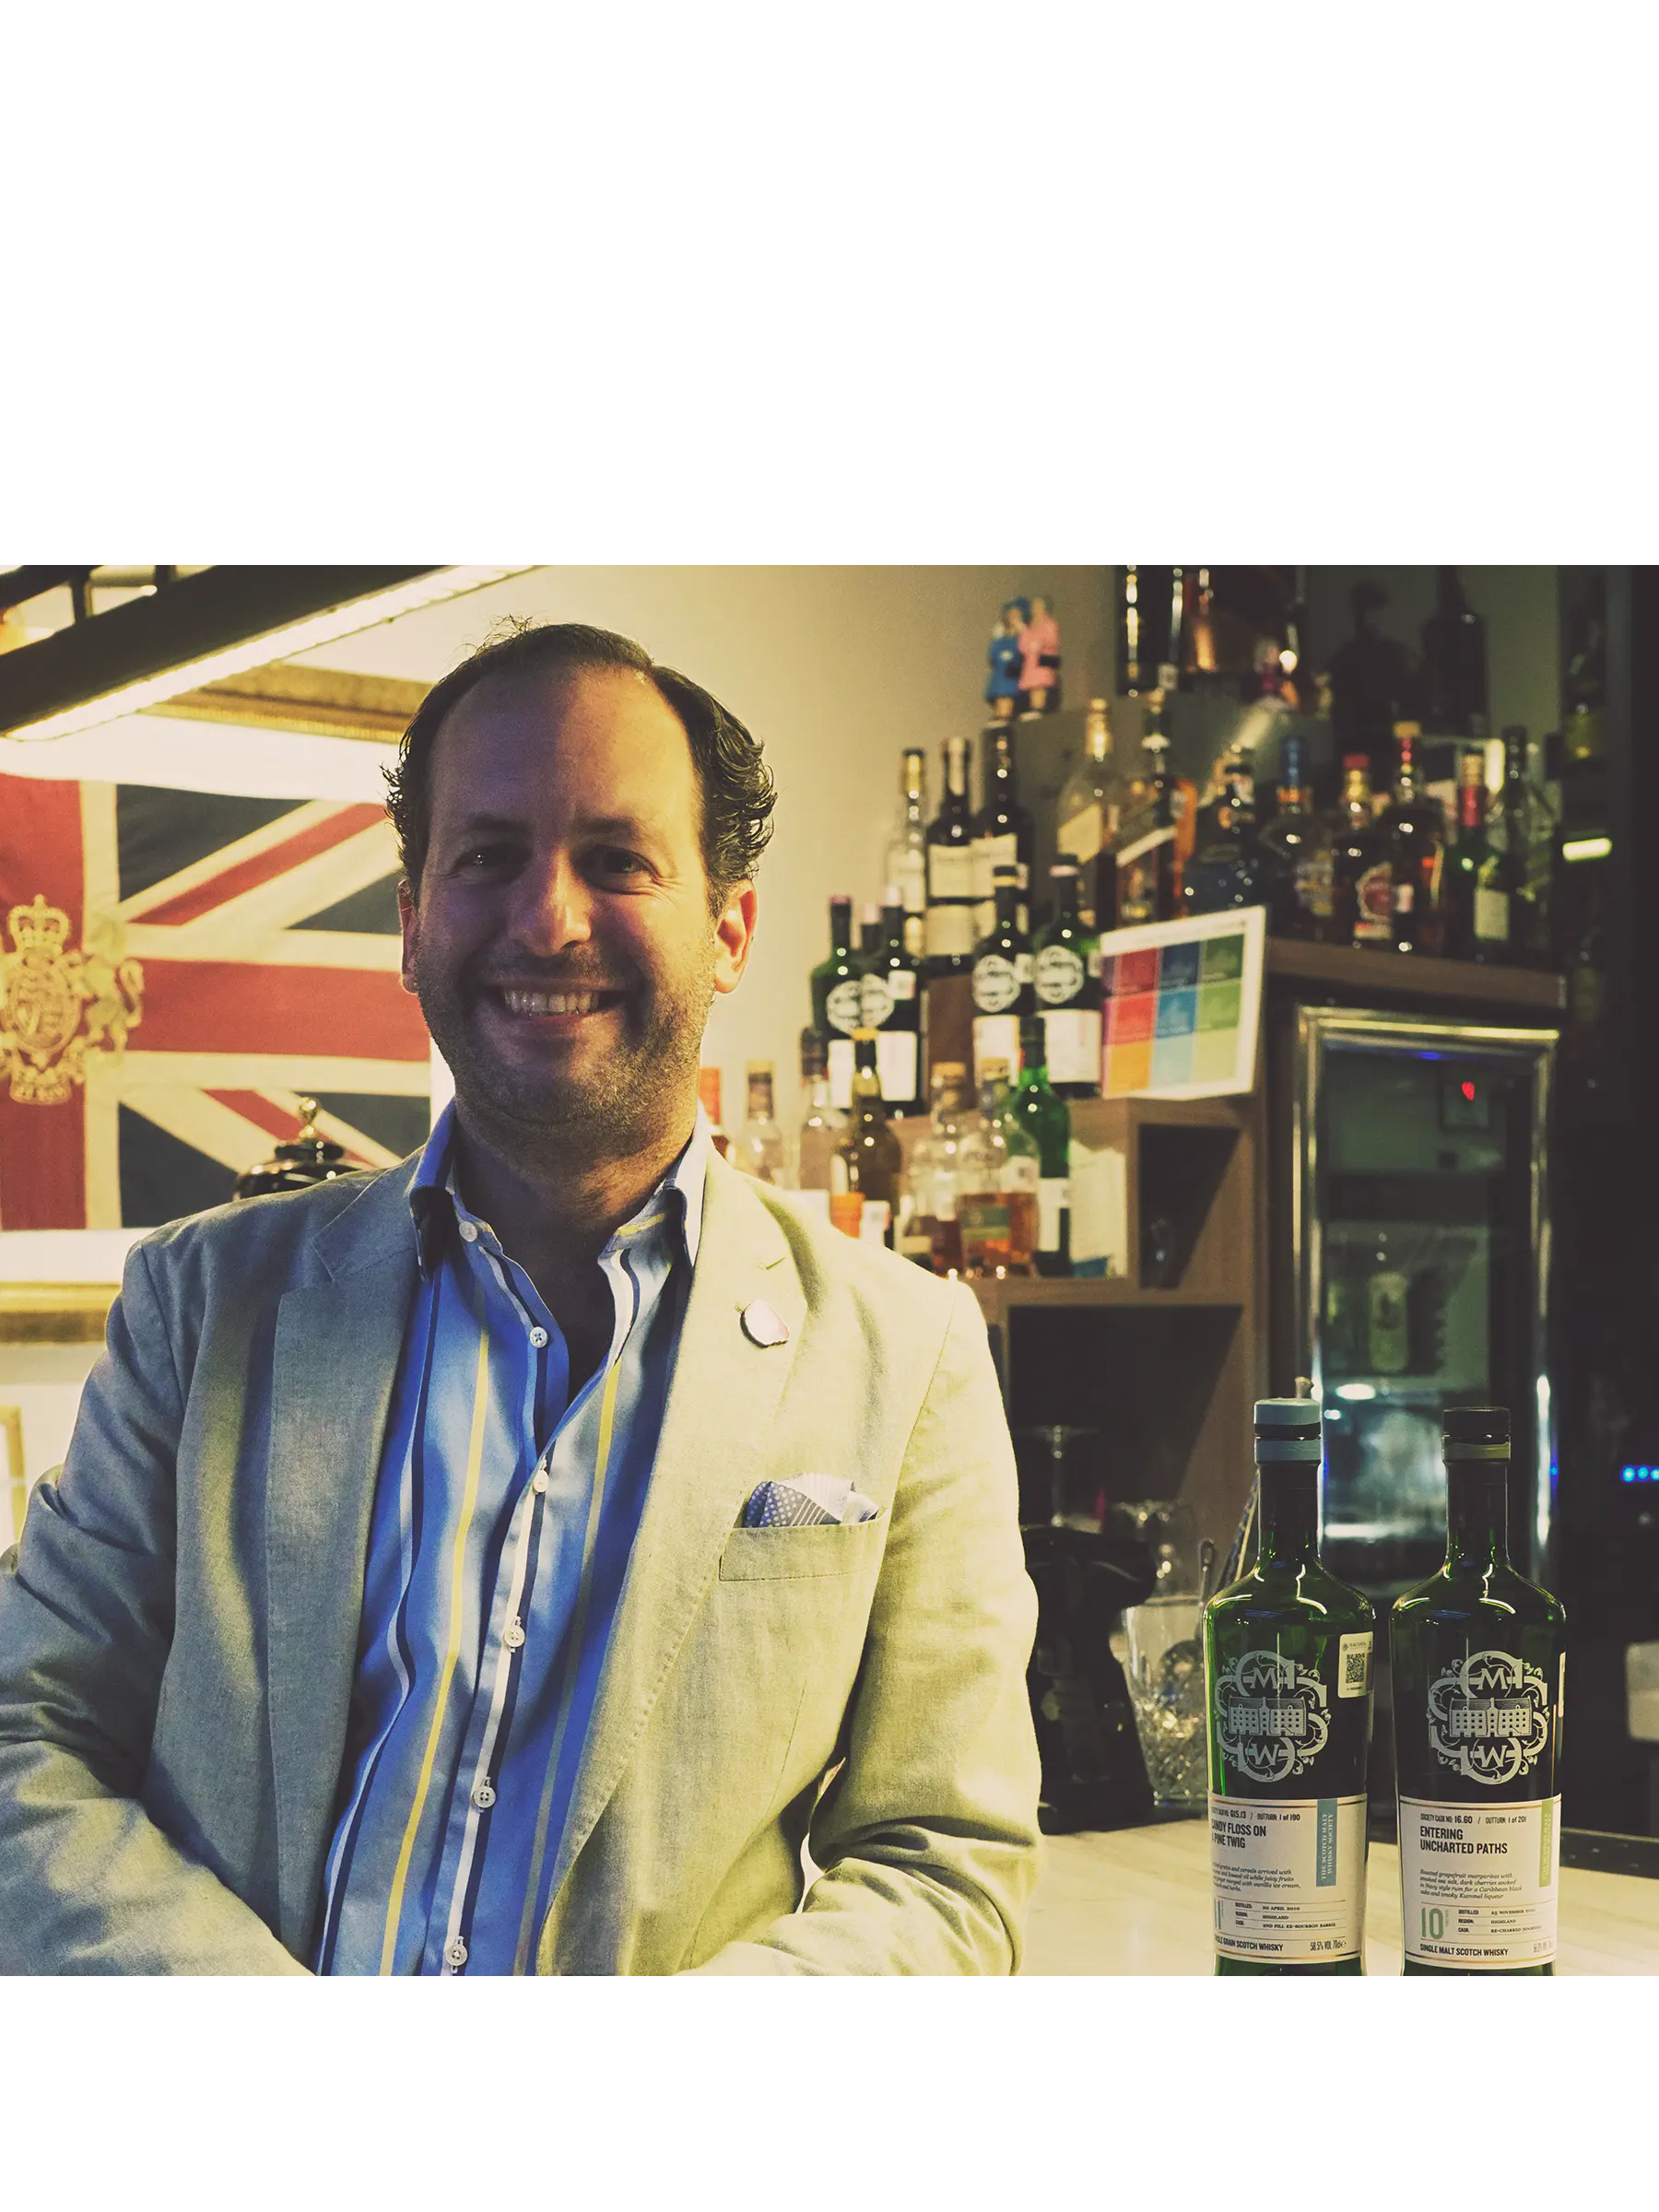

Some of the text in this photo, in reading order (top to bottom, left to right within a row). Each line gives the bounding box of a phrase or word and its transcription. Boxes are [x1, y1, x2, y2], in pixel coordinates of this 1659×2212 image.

[1454, 1816, 1473, 1824] 16.60
[1228, 1822, 1252, 1836] FLOSS
[1253, 1825, 1266, 1837] ON
[1420, 1826, 1464, 1841] ENTERING
[1227, 1835, 1245, 1849] TWIG
[1420, 1839, 1508, 1854] UNCHARTED PATHS
[1439, 1872, 1466, 1880] grapefruit
[1420, 1906, 1444, 1940] 10
[1236, 1939, 1259, 1950] SCOTCH
[1259, 1942, 1284, 1952] WHISKY
[1419, 1943, 1509, 1957] SINGLE MALT SCOTCH WHISKY
